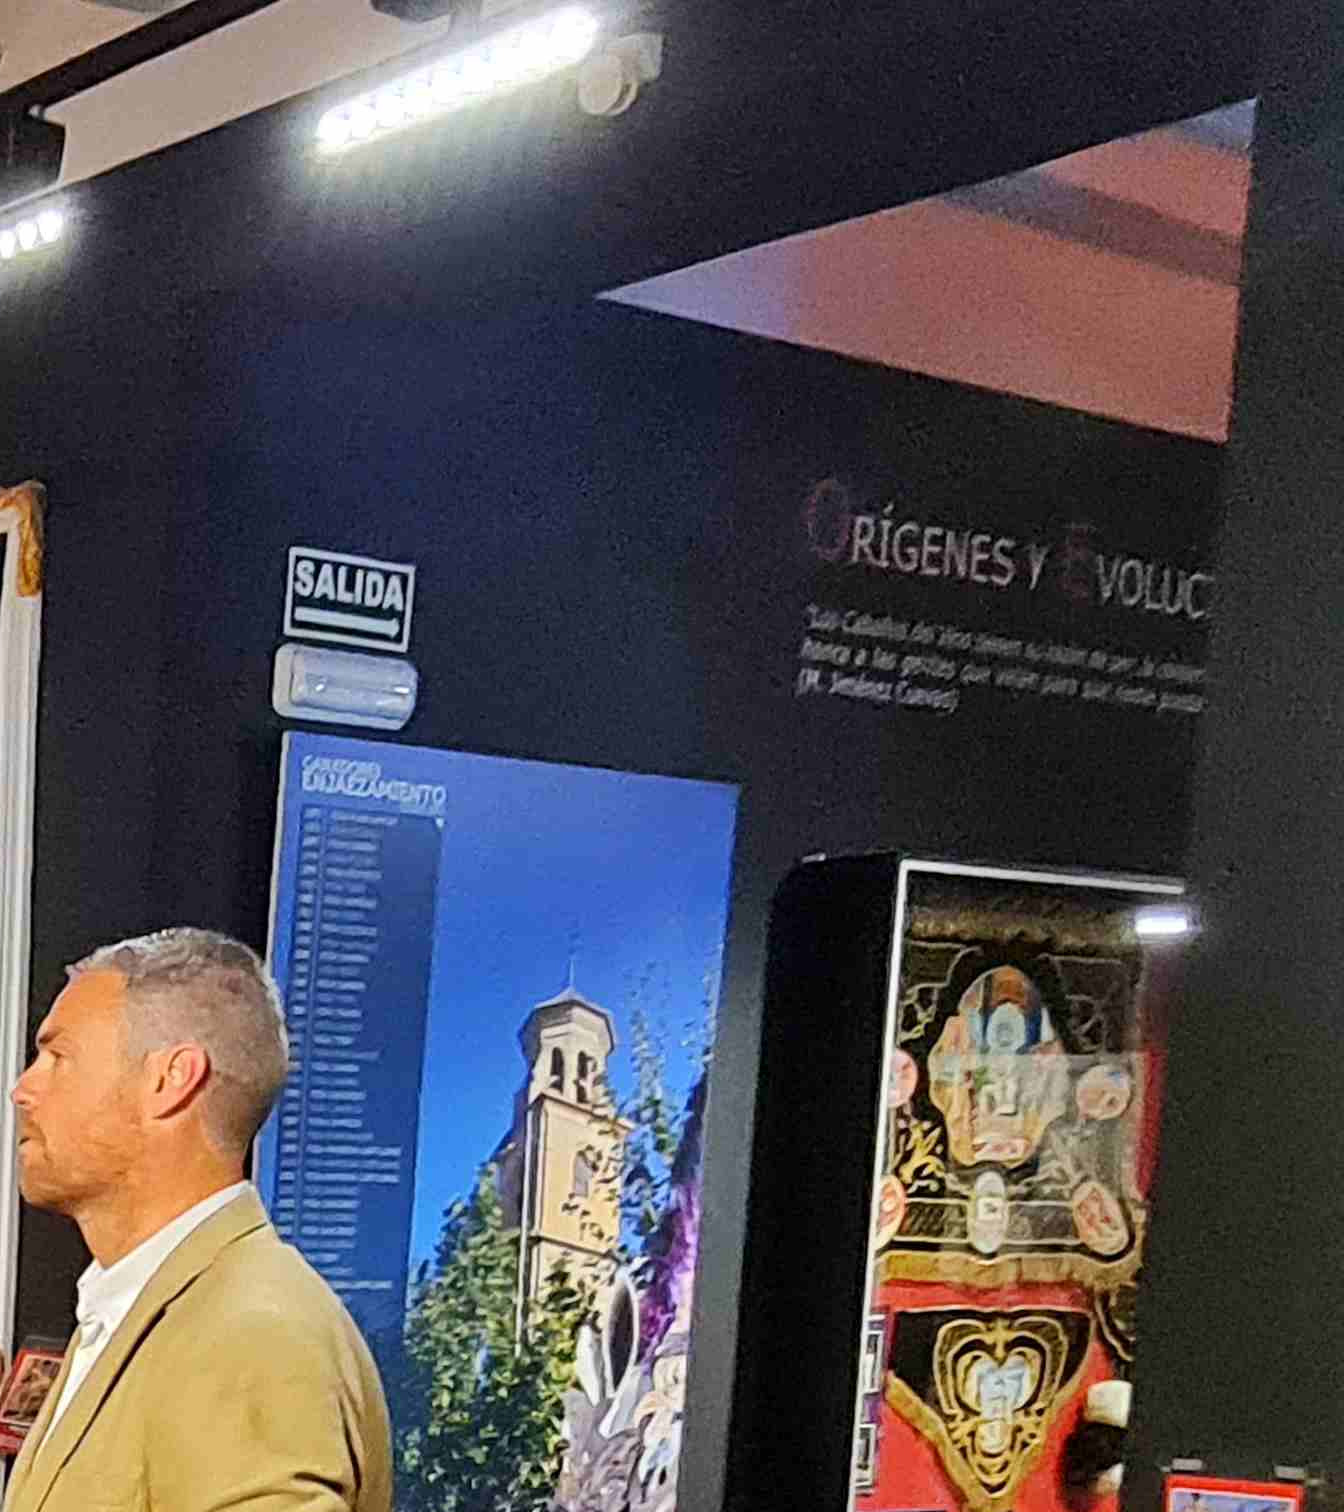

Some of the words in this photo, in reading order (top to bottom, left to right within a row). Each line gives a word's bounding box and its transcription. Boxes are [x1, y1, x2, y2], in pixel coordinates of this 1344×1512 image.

[806, 479, 1016, 587] ORÍGENES
[1025, 544, 1050, 590] Y
[294, 560, 404, 611] SALIDA
